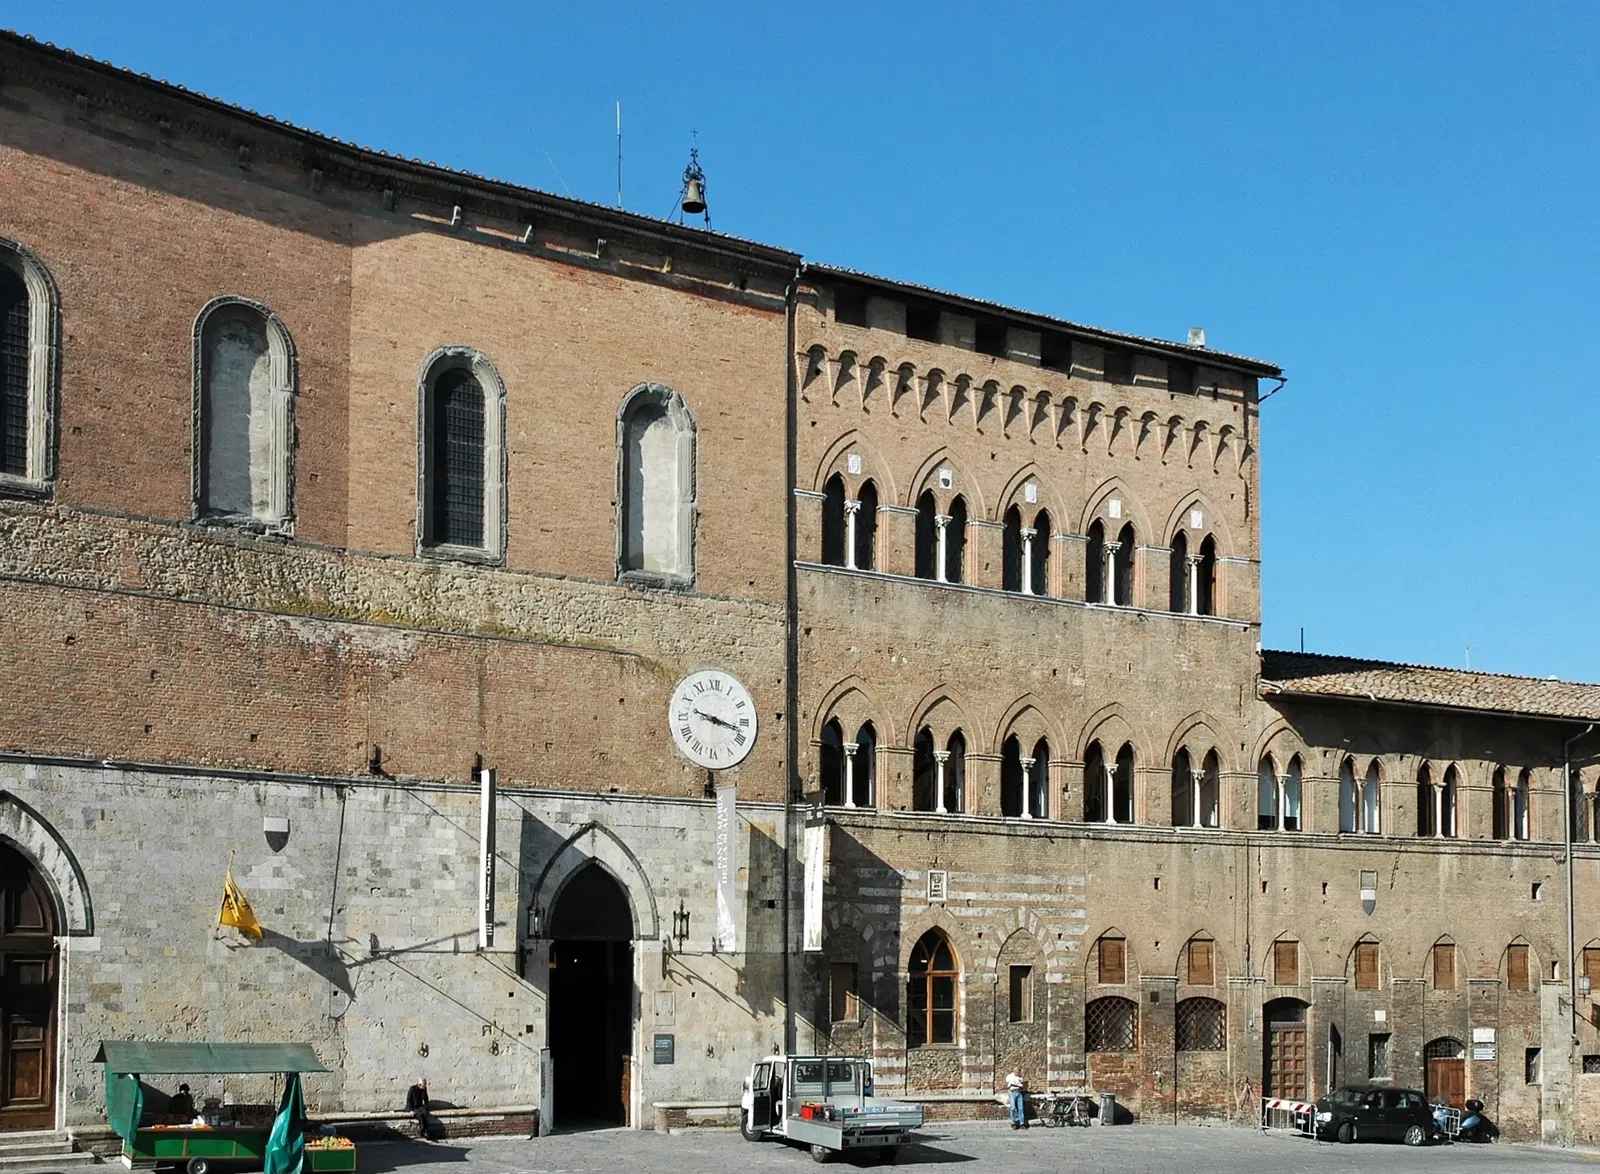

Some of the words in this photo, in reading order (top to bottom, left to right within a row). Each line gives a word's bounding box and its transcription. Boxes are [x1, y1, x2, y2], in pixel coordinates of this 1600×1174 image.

[693, 681, 705, 693] XI
[709, 679, 721, 691] XII
[727, 686, 733, 696] I
[682, 694, 693, 705] X
[736, 701, 745, 709] II
[678, 711, 688, 721] IX
[740, 718, 749, 727] III
[709, 748, 718, 760] VI
